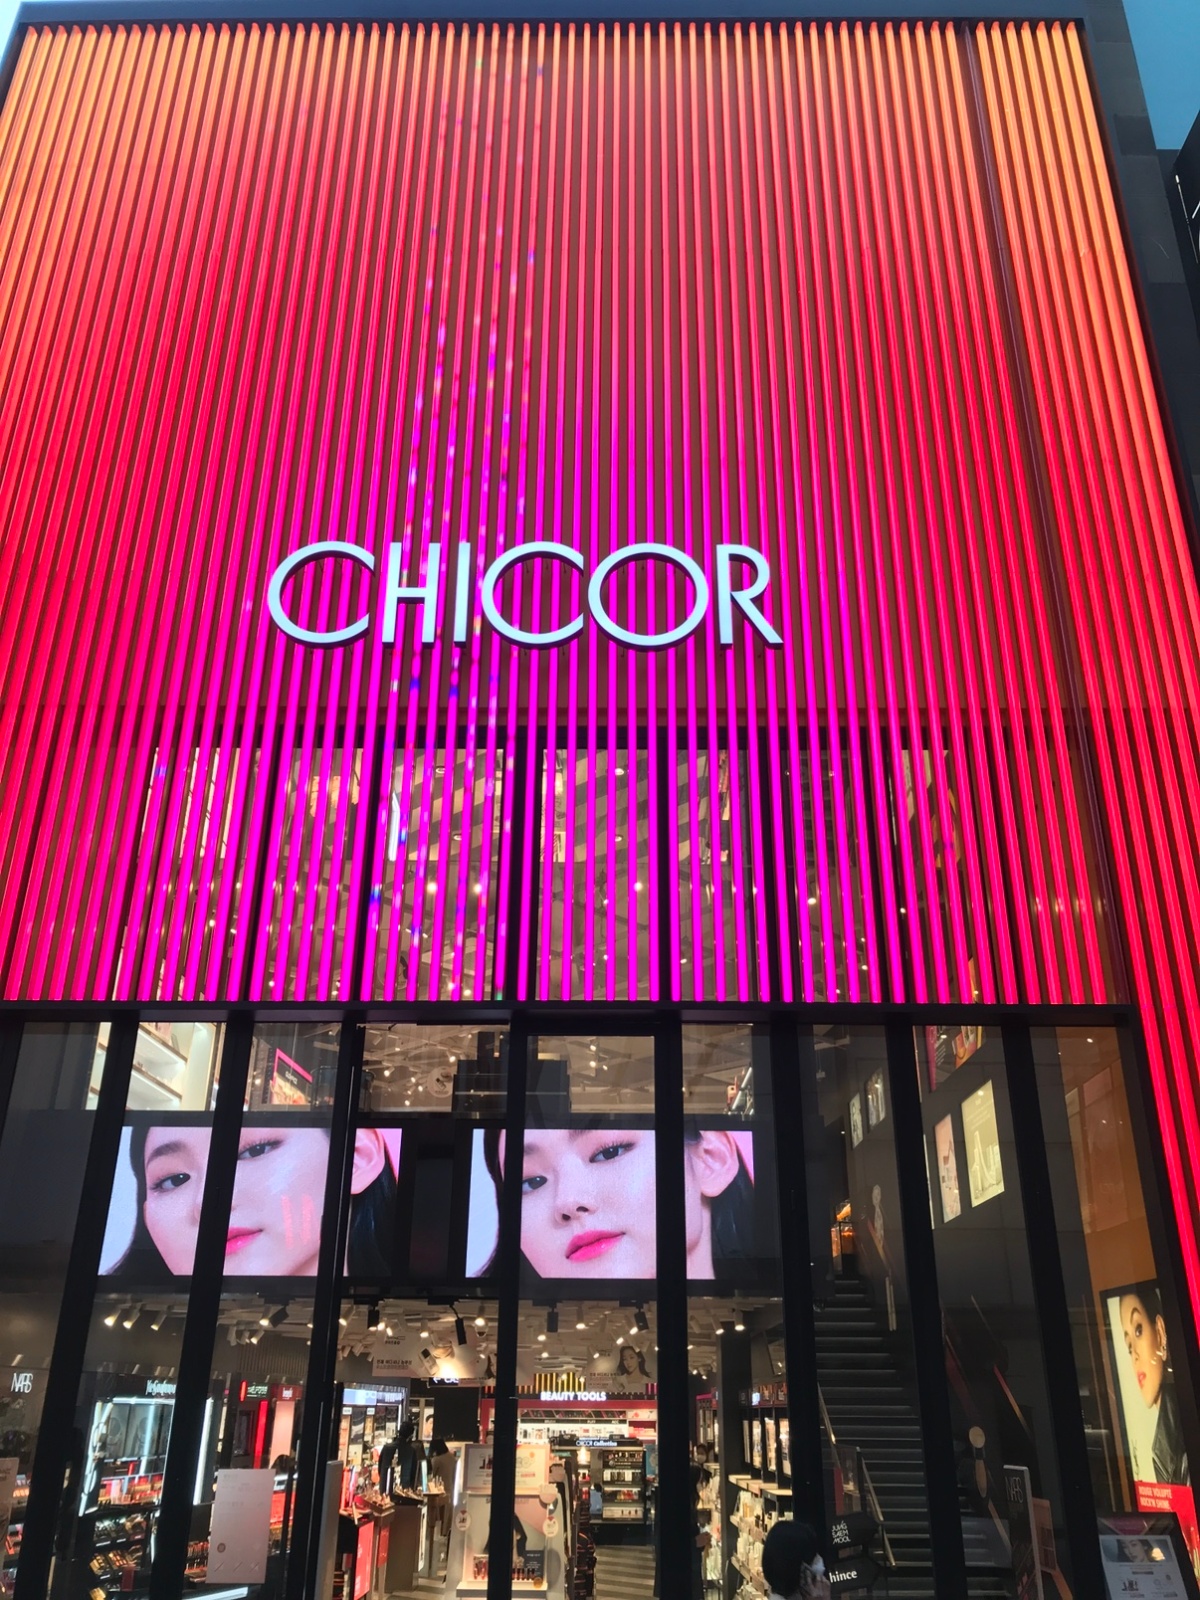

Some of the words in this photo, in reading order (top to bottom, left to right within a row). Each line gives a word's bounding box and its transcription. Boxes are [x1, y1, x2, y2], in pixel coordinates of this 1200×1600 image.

[267, 540, 783, 648] CHICOR
[10, 1372, 34, 1393] NARS
[540, 1391, 575, 1401] BEAUTY
[576, 1391, 607, 1401] TOOLS
[1005, 1476, 1024, 1503] NARS
[832, 1530, 849, 1538] SAEM
[833, 1536, 851, 1544] MOOL
[829, 1570, 858, 1583] hince
